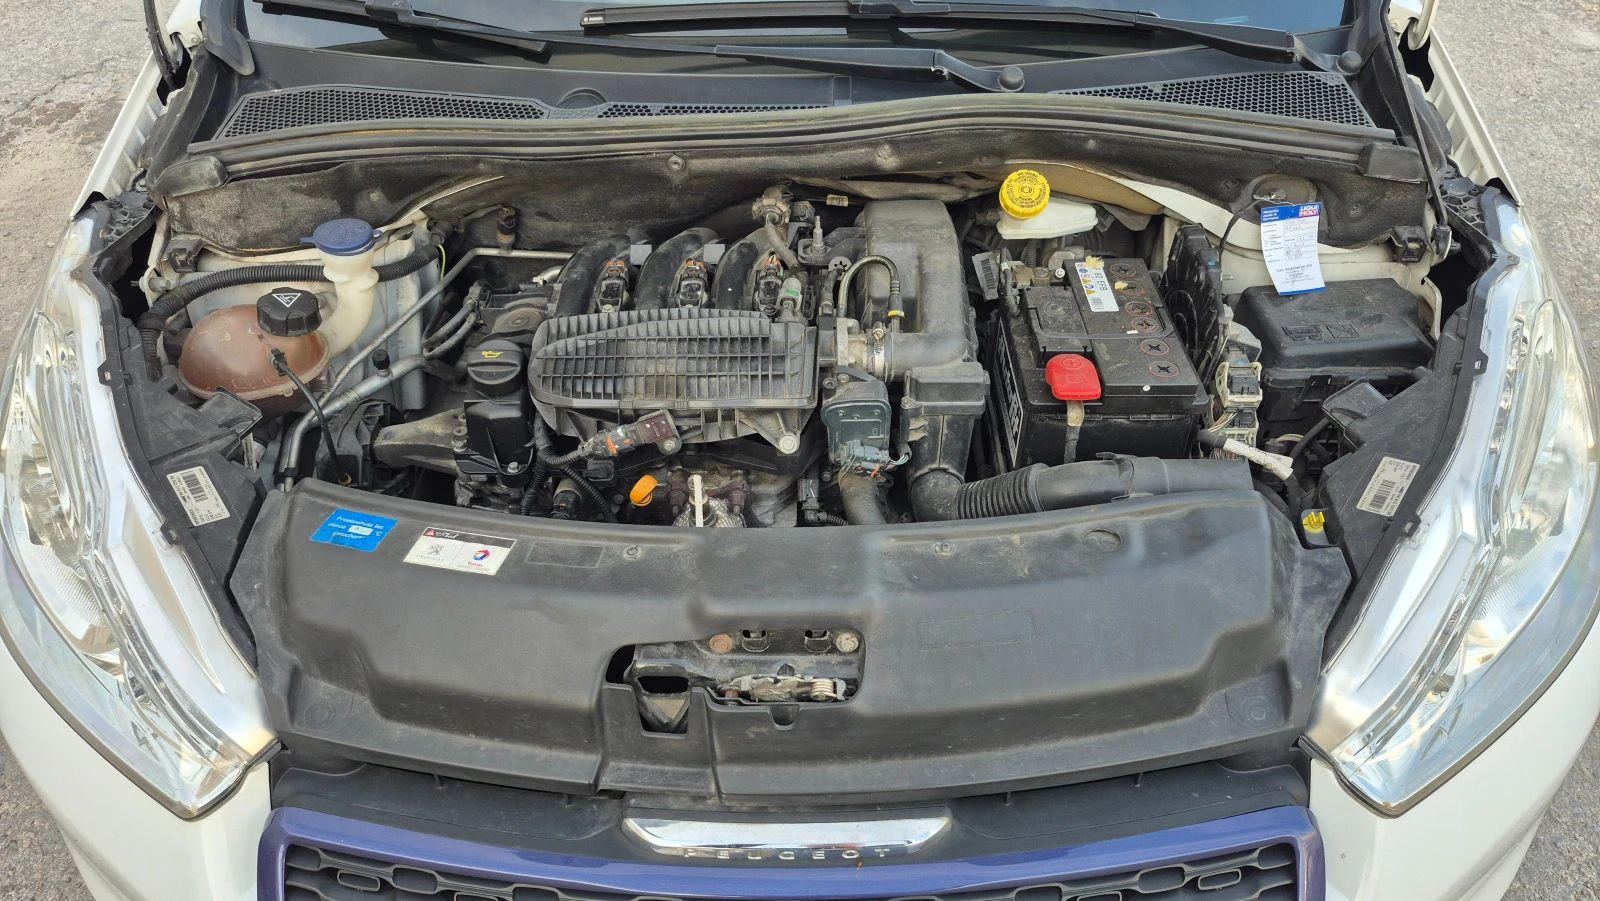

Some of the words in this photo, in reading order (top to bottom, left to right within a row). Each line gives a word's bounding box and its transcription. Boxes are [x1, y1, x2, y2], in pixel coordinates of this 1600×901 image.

[327, 522, 347, 530] minus
[337, 516, 374, 528] Frostschutz
[684, 848, 890, 860] PEUGEOT
